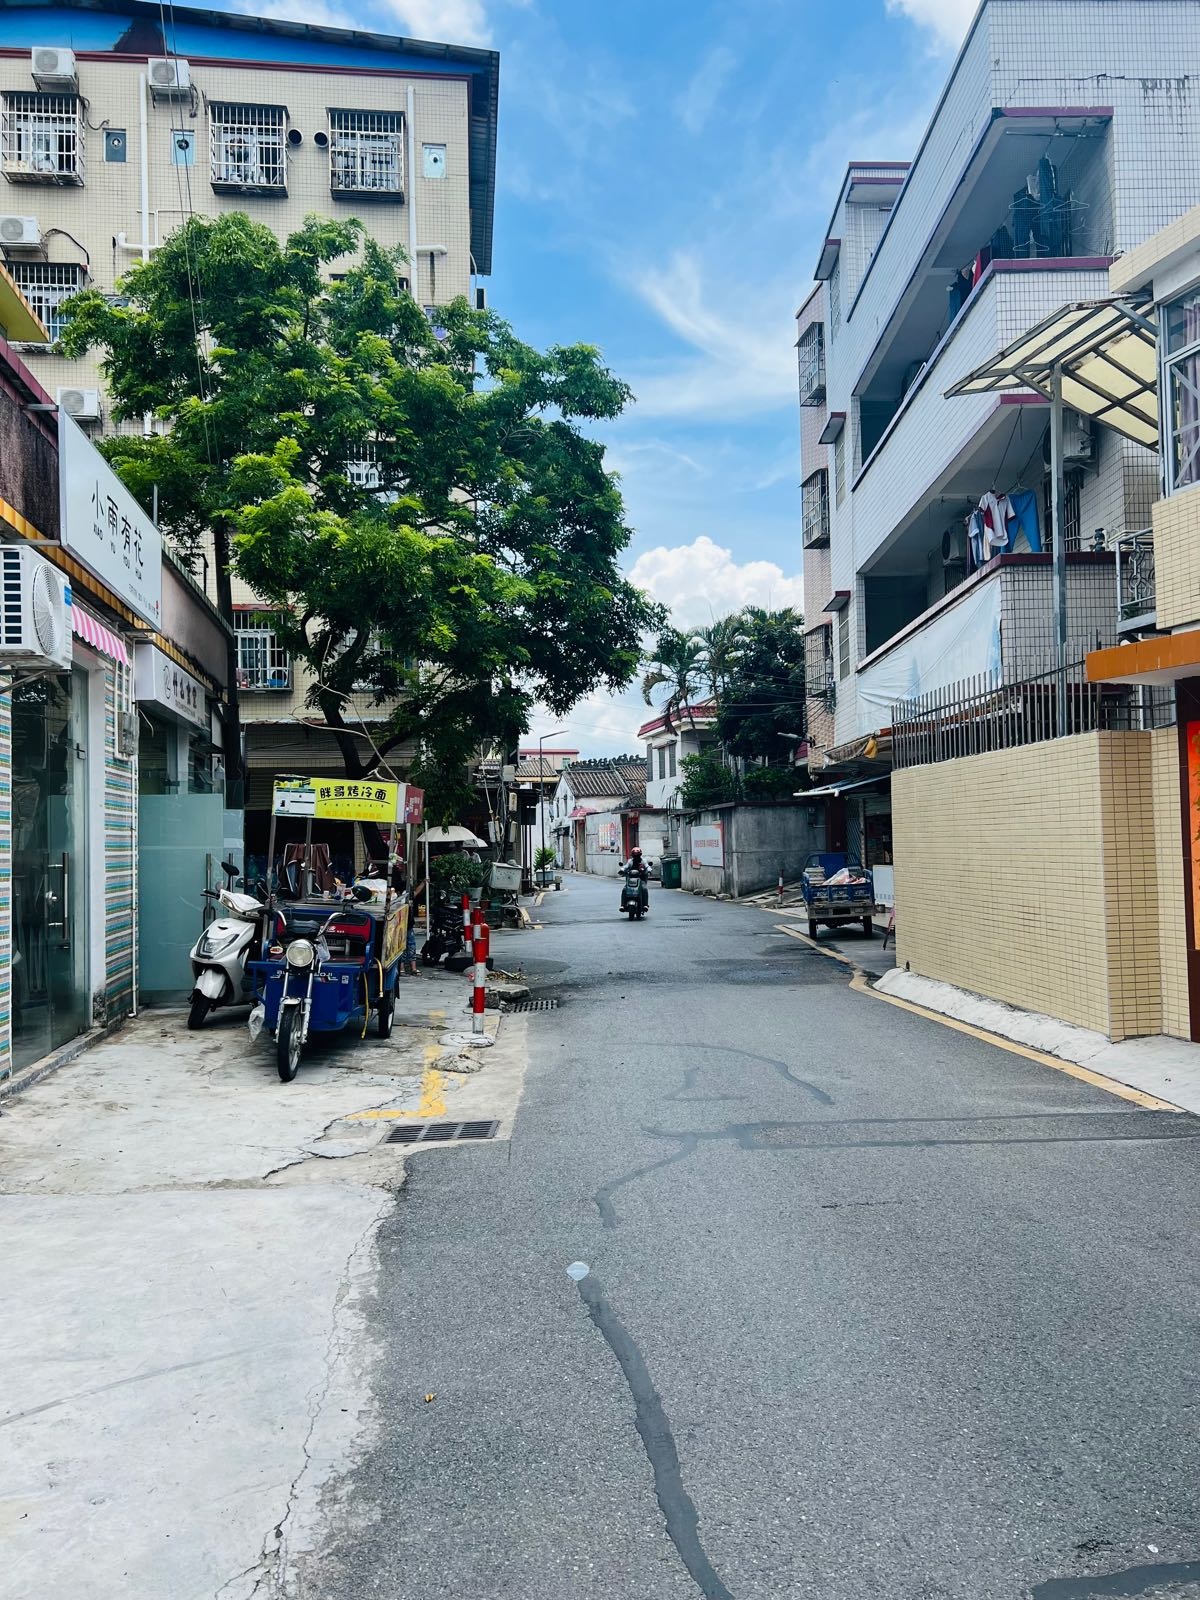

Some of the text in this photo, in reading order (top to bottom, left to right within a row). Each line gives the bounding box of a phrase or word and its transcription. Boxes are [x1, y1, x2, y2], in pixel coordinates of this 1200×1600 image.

[91, 479, 144, 567] 小雨有花
[93, 522, 104, 541] XIAO
[122, 554, 131, 570] YOU
[319, 785, 387, 801] 胖哥烤冷面
